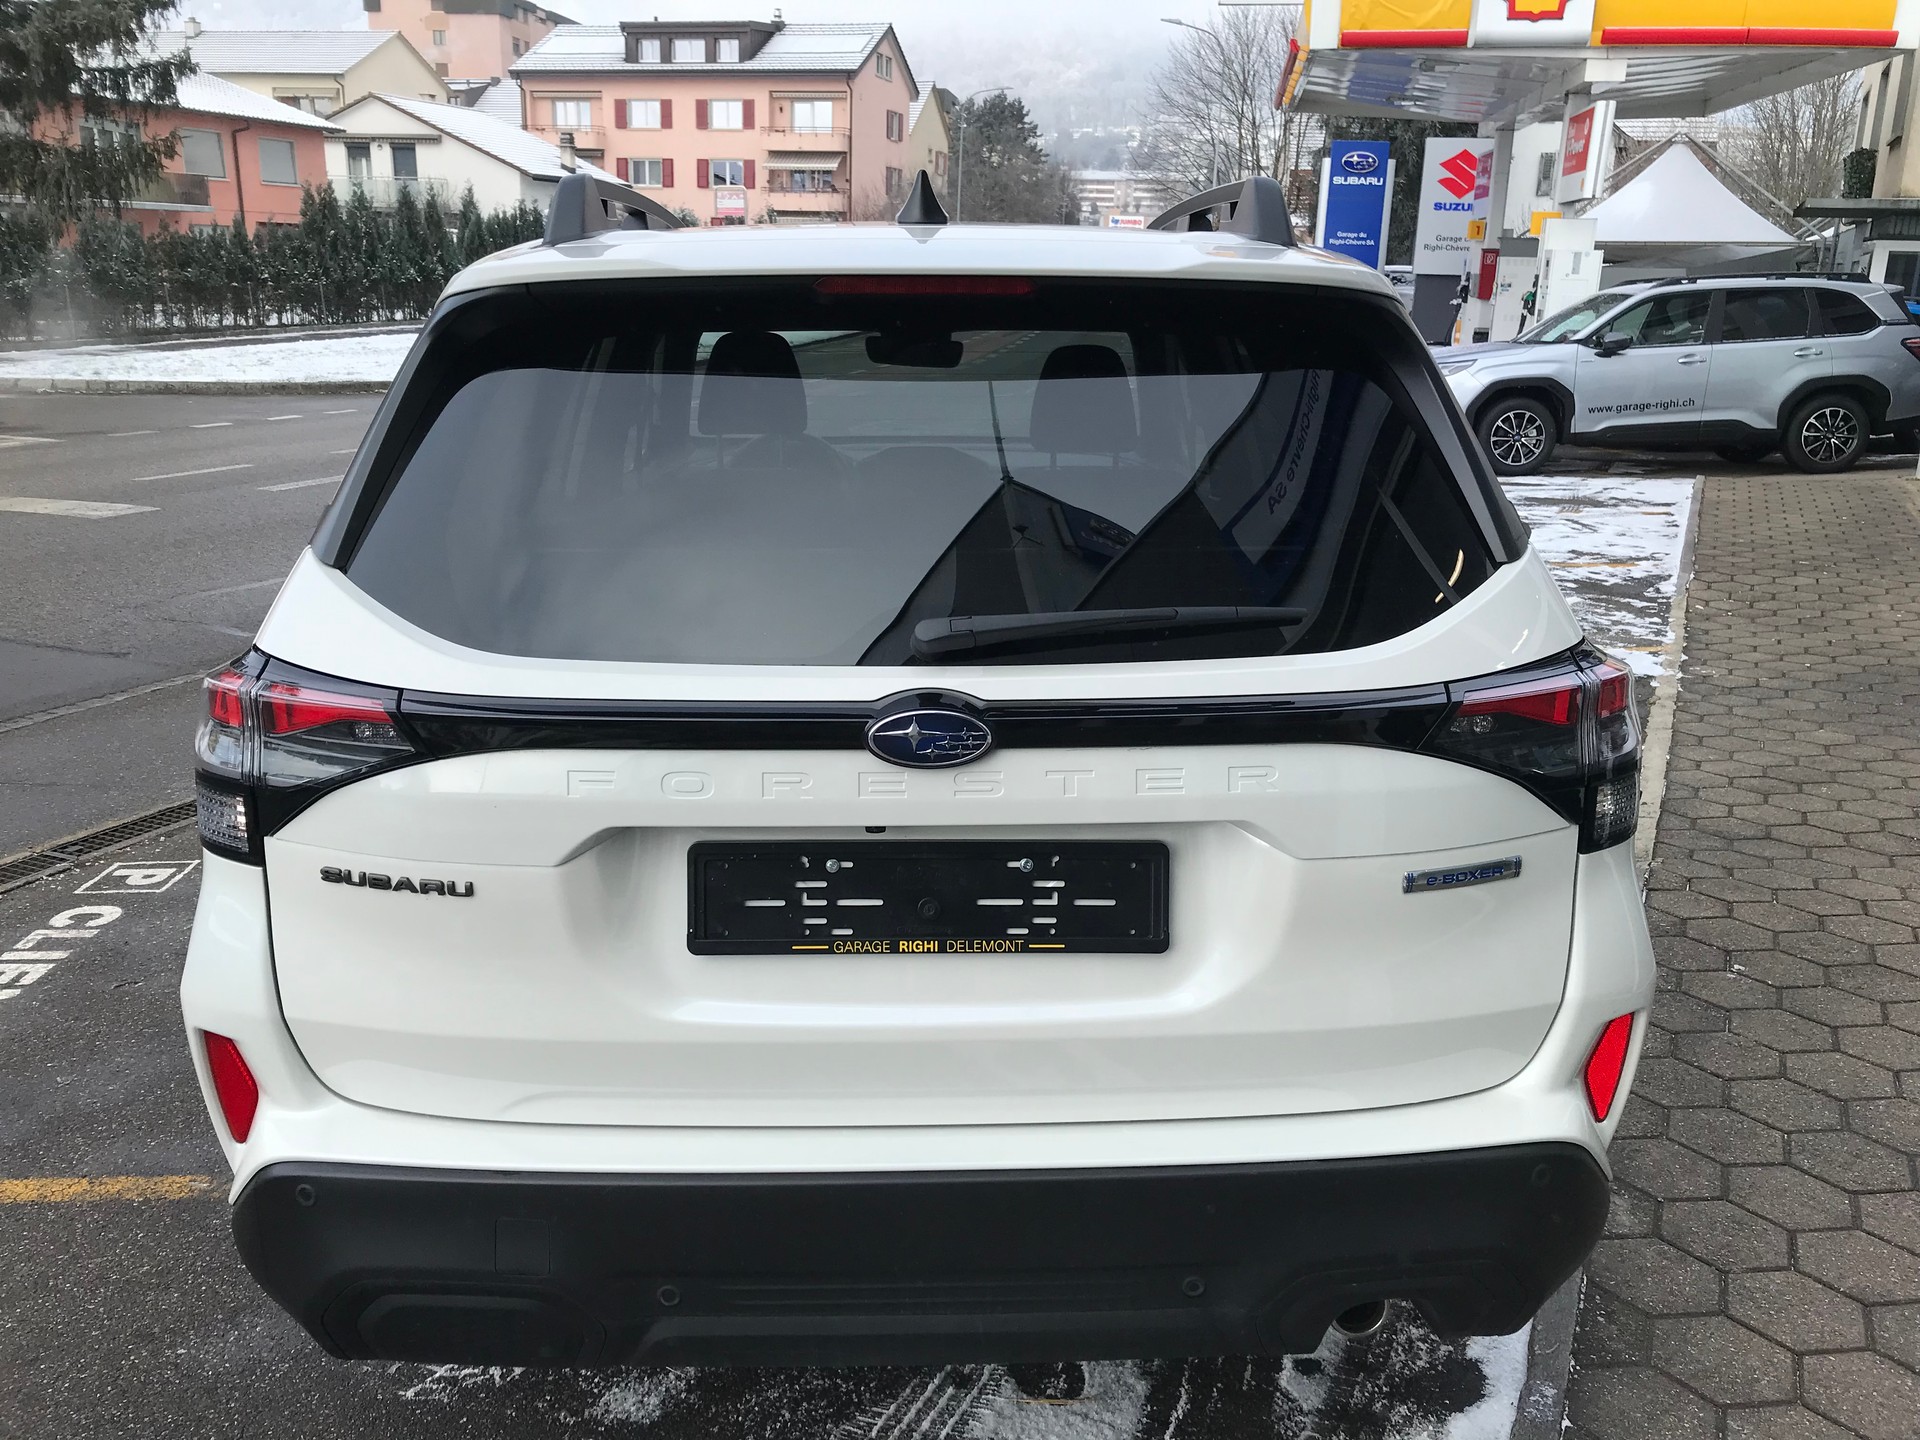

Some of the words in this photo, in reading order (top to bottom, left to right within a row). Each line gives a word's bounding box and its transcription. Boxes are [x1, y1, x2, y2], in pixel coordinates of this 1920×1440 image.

[1333, 176, 1384, 186] SUBARU
[1337, 231, 1358, 239] Garage
[1475, 225, 1481, 236] 1
[1436, 235, 1463, 244] Garage
[1588, 398, 1695, 414] www.garage-righi.ch
[566, 765, 1280, 799] FORESTER
[112, 868, 177, 885] P
[320, 866, 474, 898] SUBARU
[1426, 866, 1504, 885] e-BOXER
[833, 940, 891, 953] GARAGE
[899, 940, 940, 953] RIGHI
[946, 940, 1025, 953] DELEMONT
